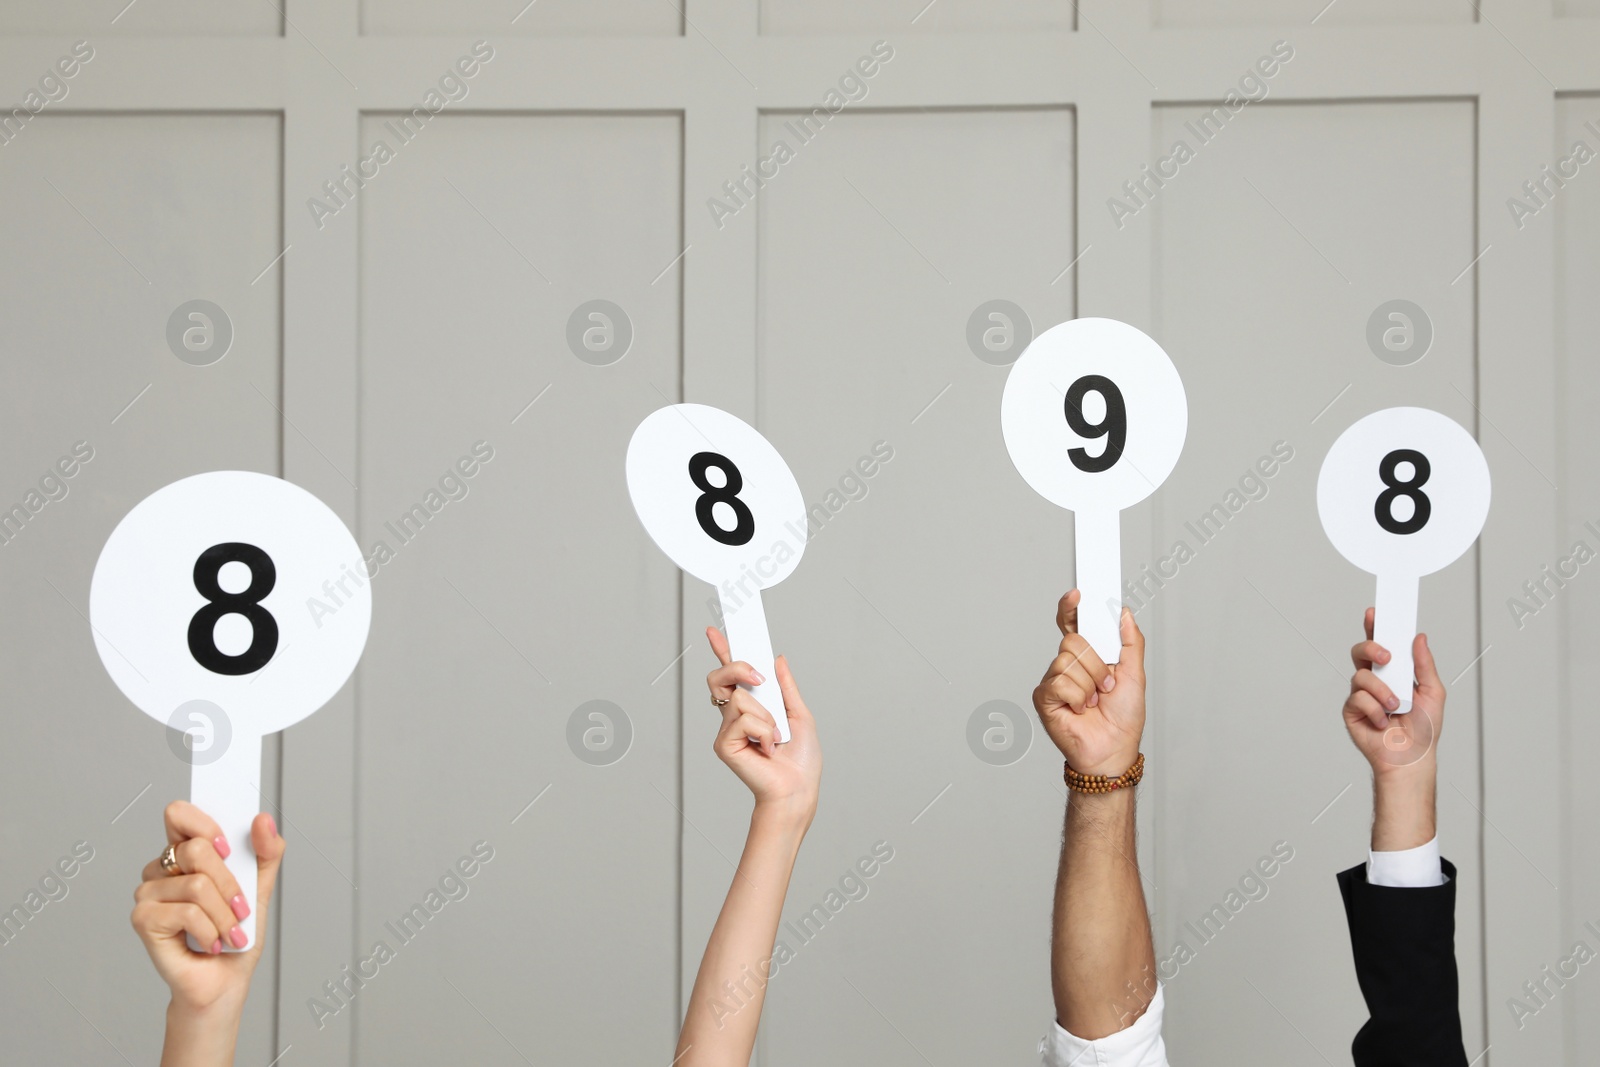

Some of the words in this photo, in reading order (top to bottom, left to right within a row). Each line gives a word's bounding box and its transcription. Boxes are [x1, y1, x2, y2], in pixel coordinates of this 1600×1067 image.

[1065, 375, 1126, 472] 9
[689, 452, 754, 546] 8
[1375, 450, 1431, 534] 8
[188, 543, 278, 675] 8
